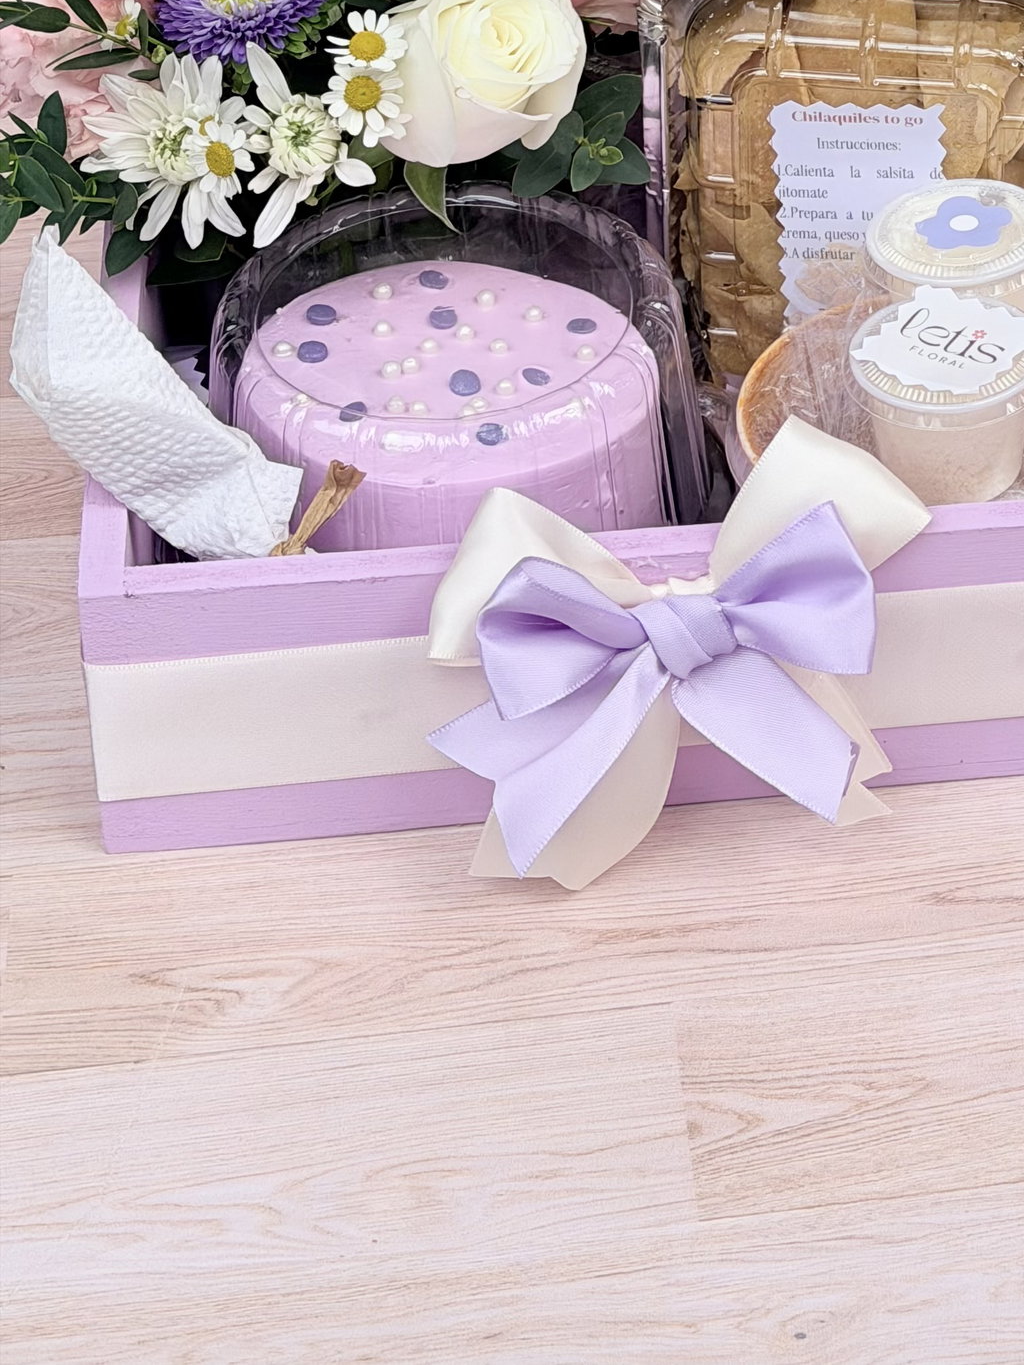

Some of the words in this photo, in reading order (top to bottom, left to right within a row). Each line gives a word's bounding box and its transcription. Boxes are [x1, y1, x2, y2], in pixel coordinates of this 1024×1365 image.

[791, 110, 881, 125] Chilaquiles
[884, 114, 901, 125] to
[904, 116, 924, 128] go
[816, 137, 902, 152] Instrucciones:
[850, 165, 862, 179] la
[876, 166, 914, 180] salsita
[778, 185, 829, 199] jitomate
[779, 206, 838, 222] 2.Prepara
[846, 211, 854, 220] a
[824, 230, 860, 243] queso
[802, 247, 857, 261] disfrutar
[900, 308, 1006, 365] letis
[909, 345, 965, 370] FLORAL
